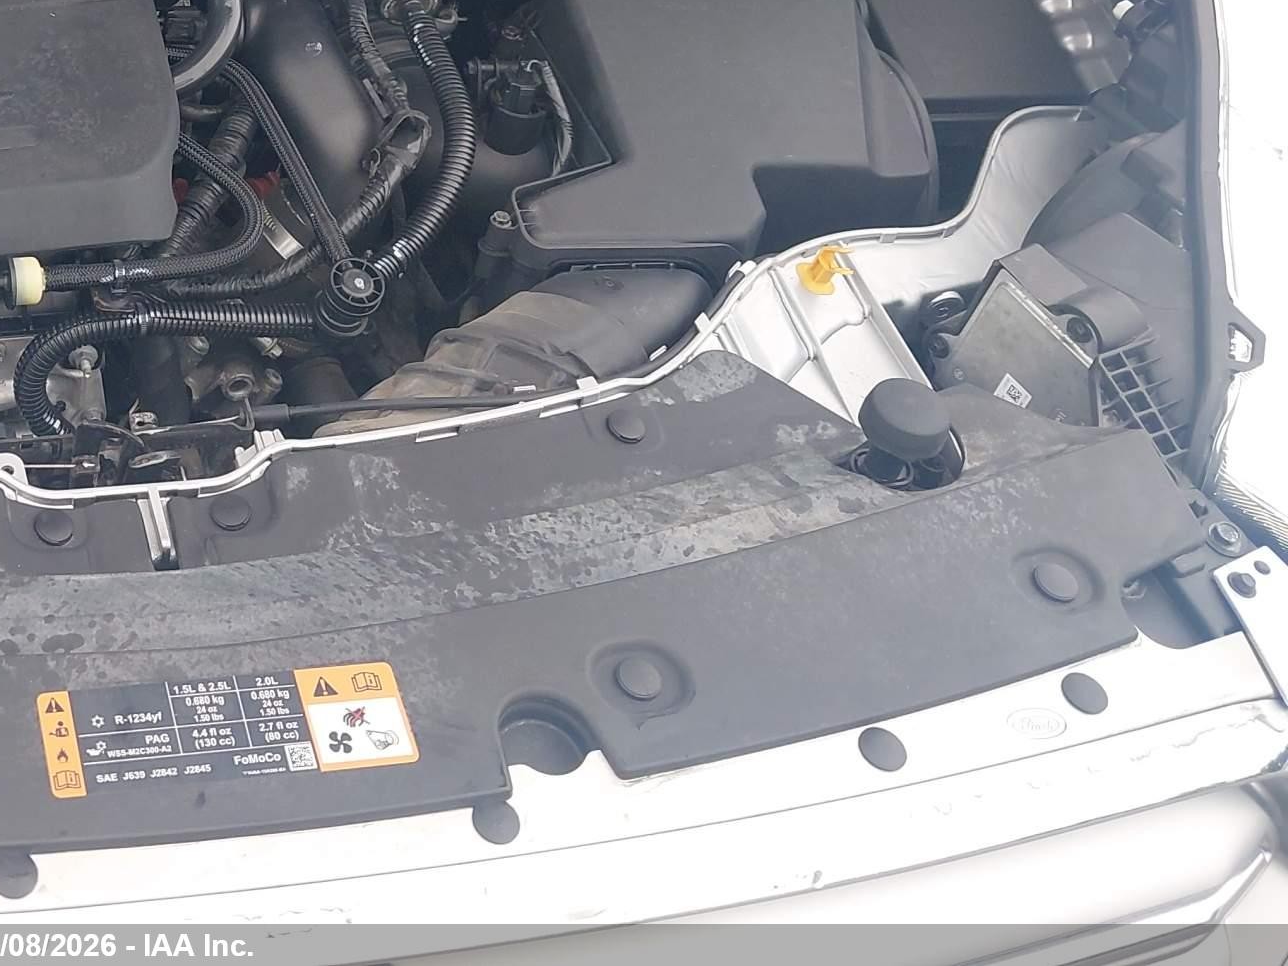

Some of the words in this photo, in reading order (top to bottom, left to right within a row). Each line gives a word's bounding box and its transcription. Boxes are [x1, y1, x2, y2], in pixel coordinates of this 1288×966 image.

[255, 677, 278, 686] 2.0L
[173, 685, 196, 694] 1.5L
[198, 683, 206, 692] &
[208, 681, 231, 691] 2.5L
[276, 689, 289, 699] kg
[212, 695, 224, 705] kg
[263, 700, 272, 708] 24
[196, 706, 206, 714] 24
[277, 707, 290, 715] lbs
[114, 712, 162, 725] R-1234yf
[212, 713, 224, 721] lbs
[259, 722, 273, 731] 2.7
[276, 722, 284, 730] fl
[286, 721, 299, 729] oz
[192, 729, 208, 738] 4.4
[210, 728, 217, 736] fl
[265, 732, 280, 743] (80
[283, 730, 299, 740] cc)
[145, 734, 170, 744] PAG
[195, 737, 217, 750] (130
[219, 736, 235, 746] cc)
[233, 753, 281, 765] FoMoCo
[96, 773, 118, 783] SAE
[122, 771, 146, 781] J639
[150, 768, 178, 778] J2842
[184, 764, 212, 775] J2845
